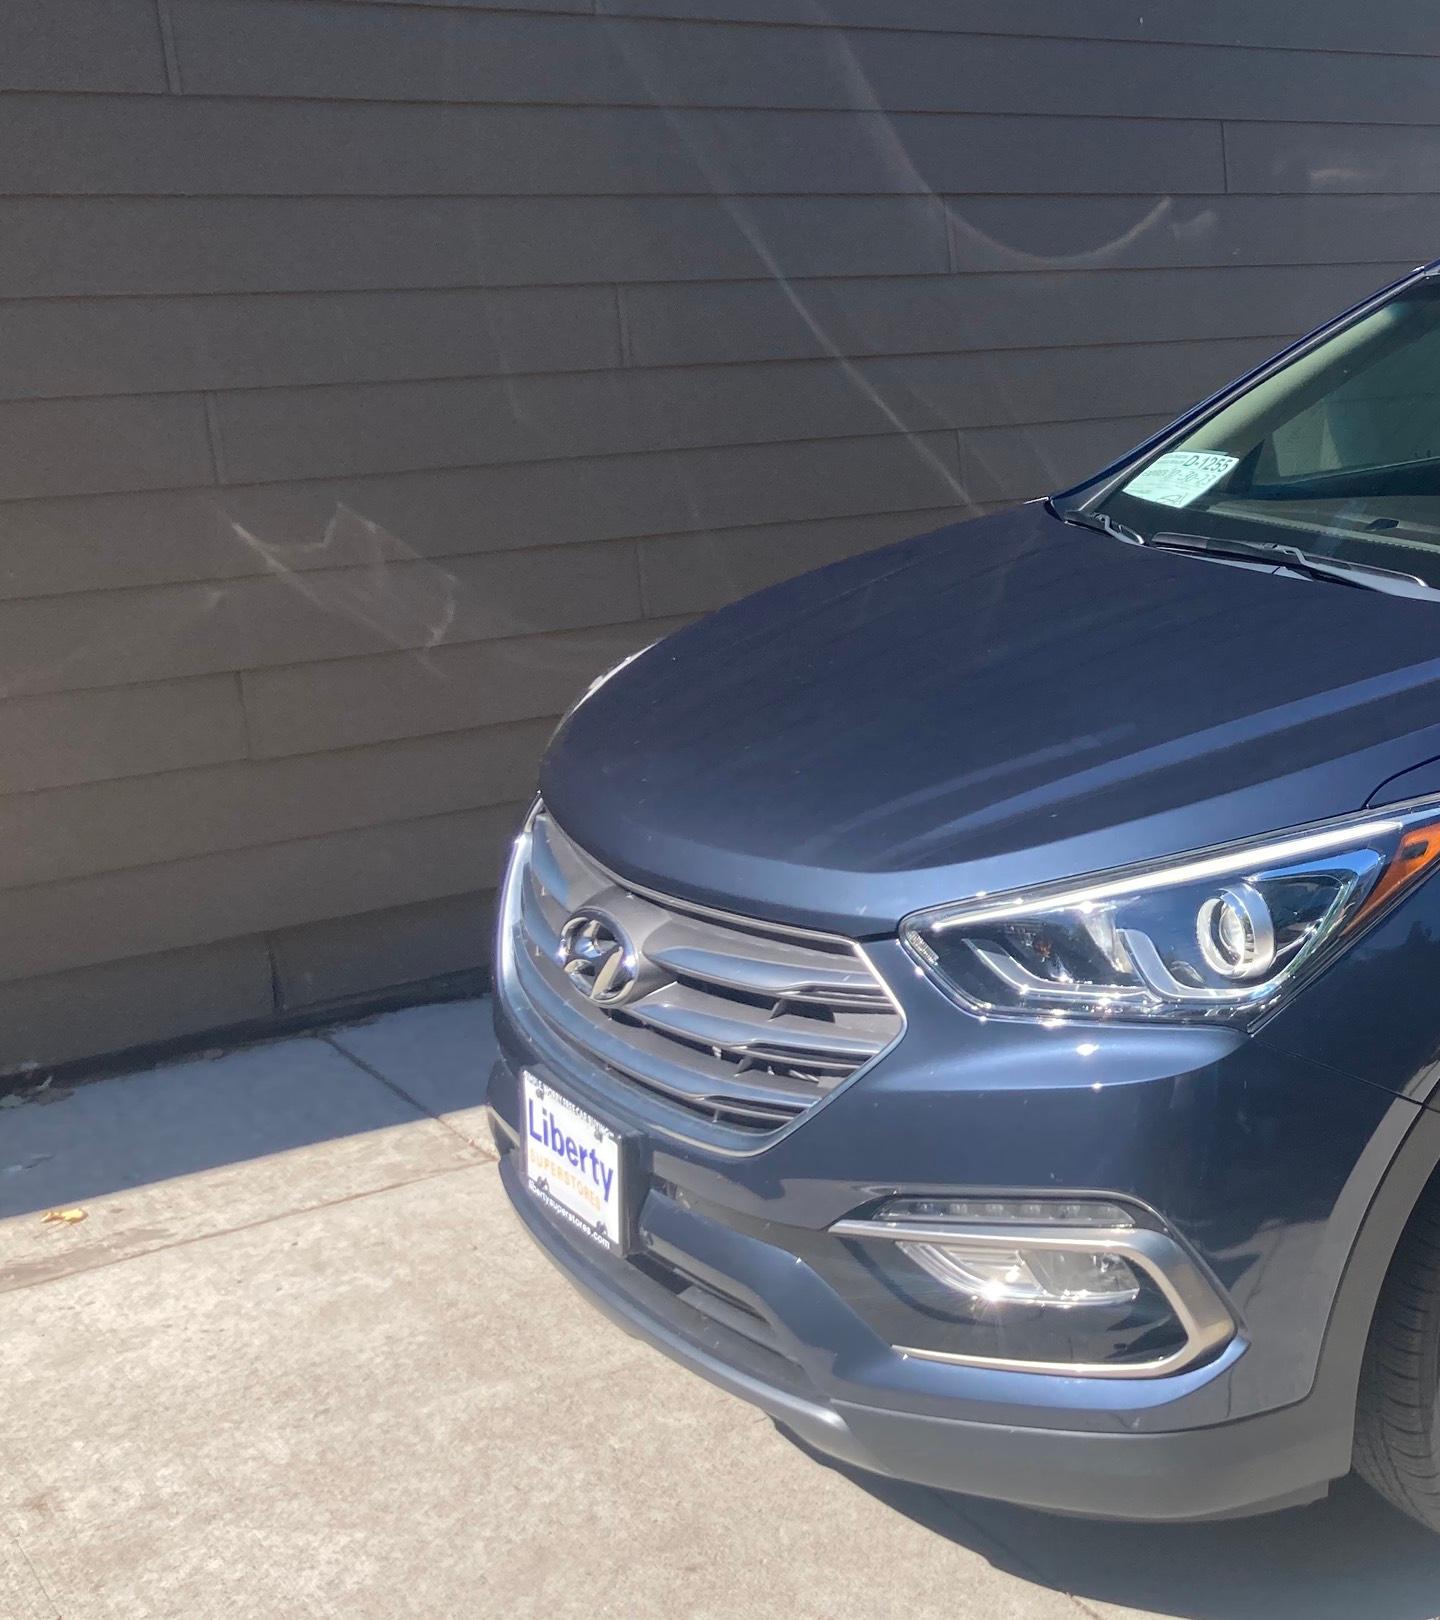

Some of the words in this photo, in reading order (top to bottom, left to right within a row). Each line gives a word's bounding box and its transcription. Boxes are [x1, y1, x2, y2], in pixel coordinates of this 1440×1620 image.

[1183, 454, 1233, 473] D-1255
[529, 1097, 614, 1203] Liberty
[529, 1146, 601, 1212] SUPERSTORES
